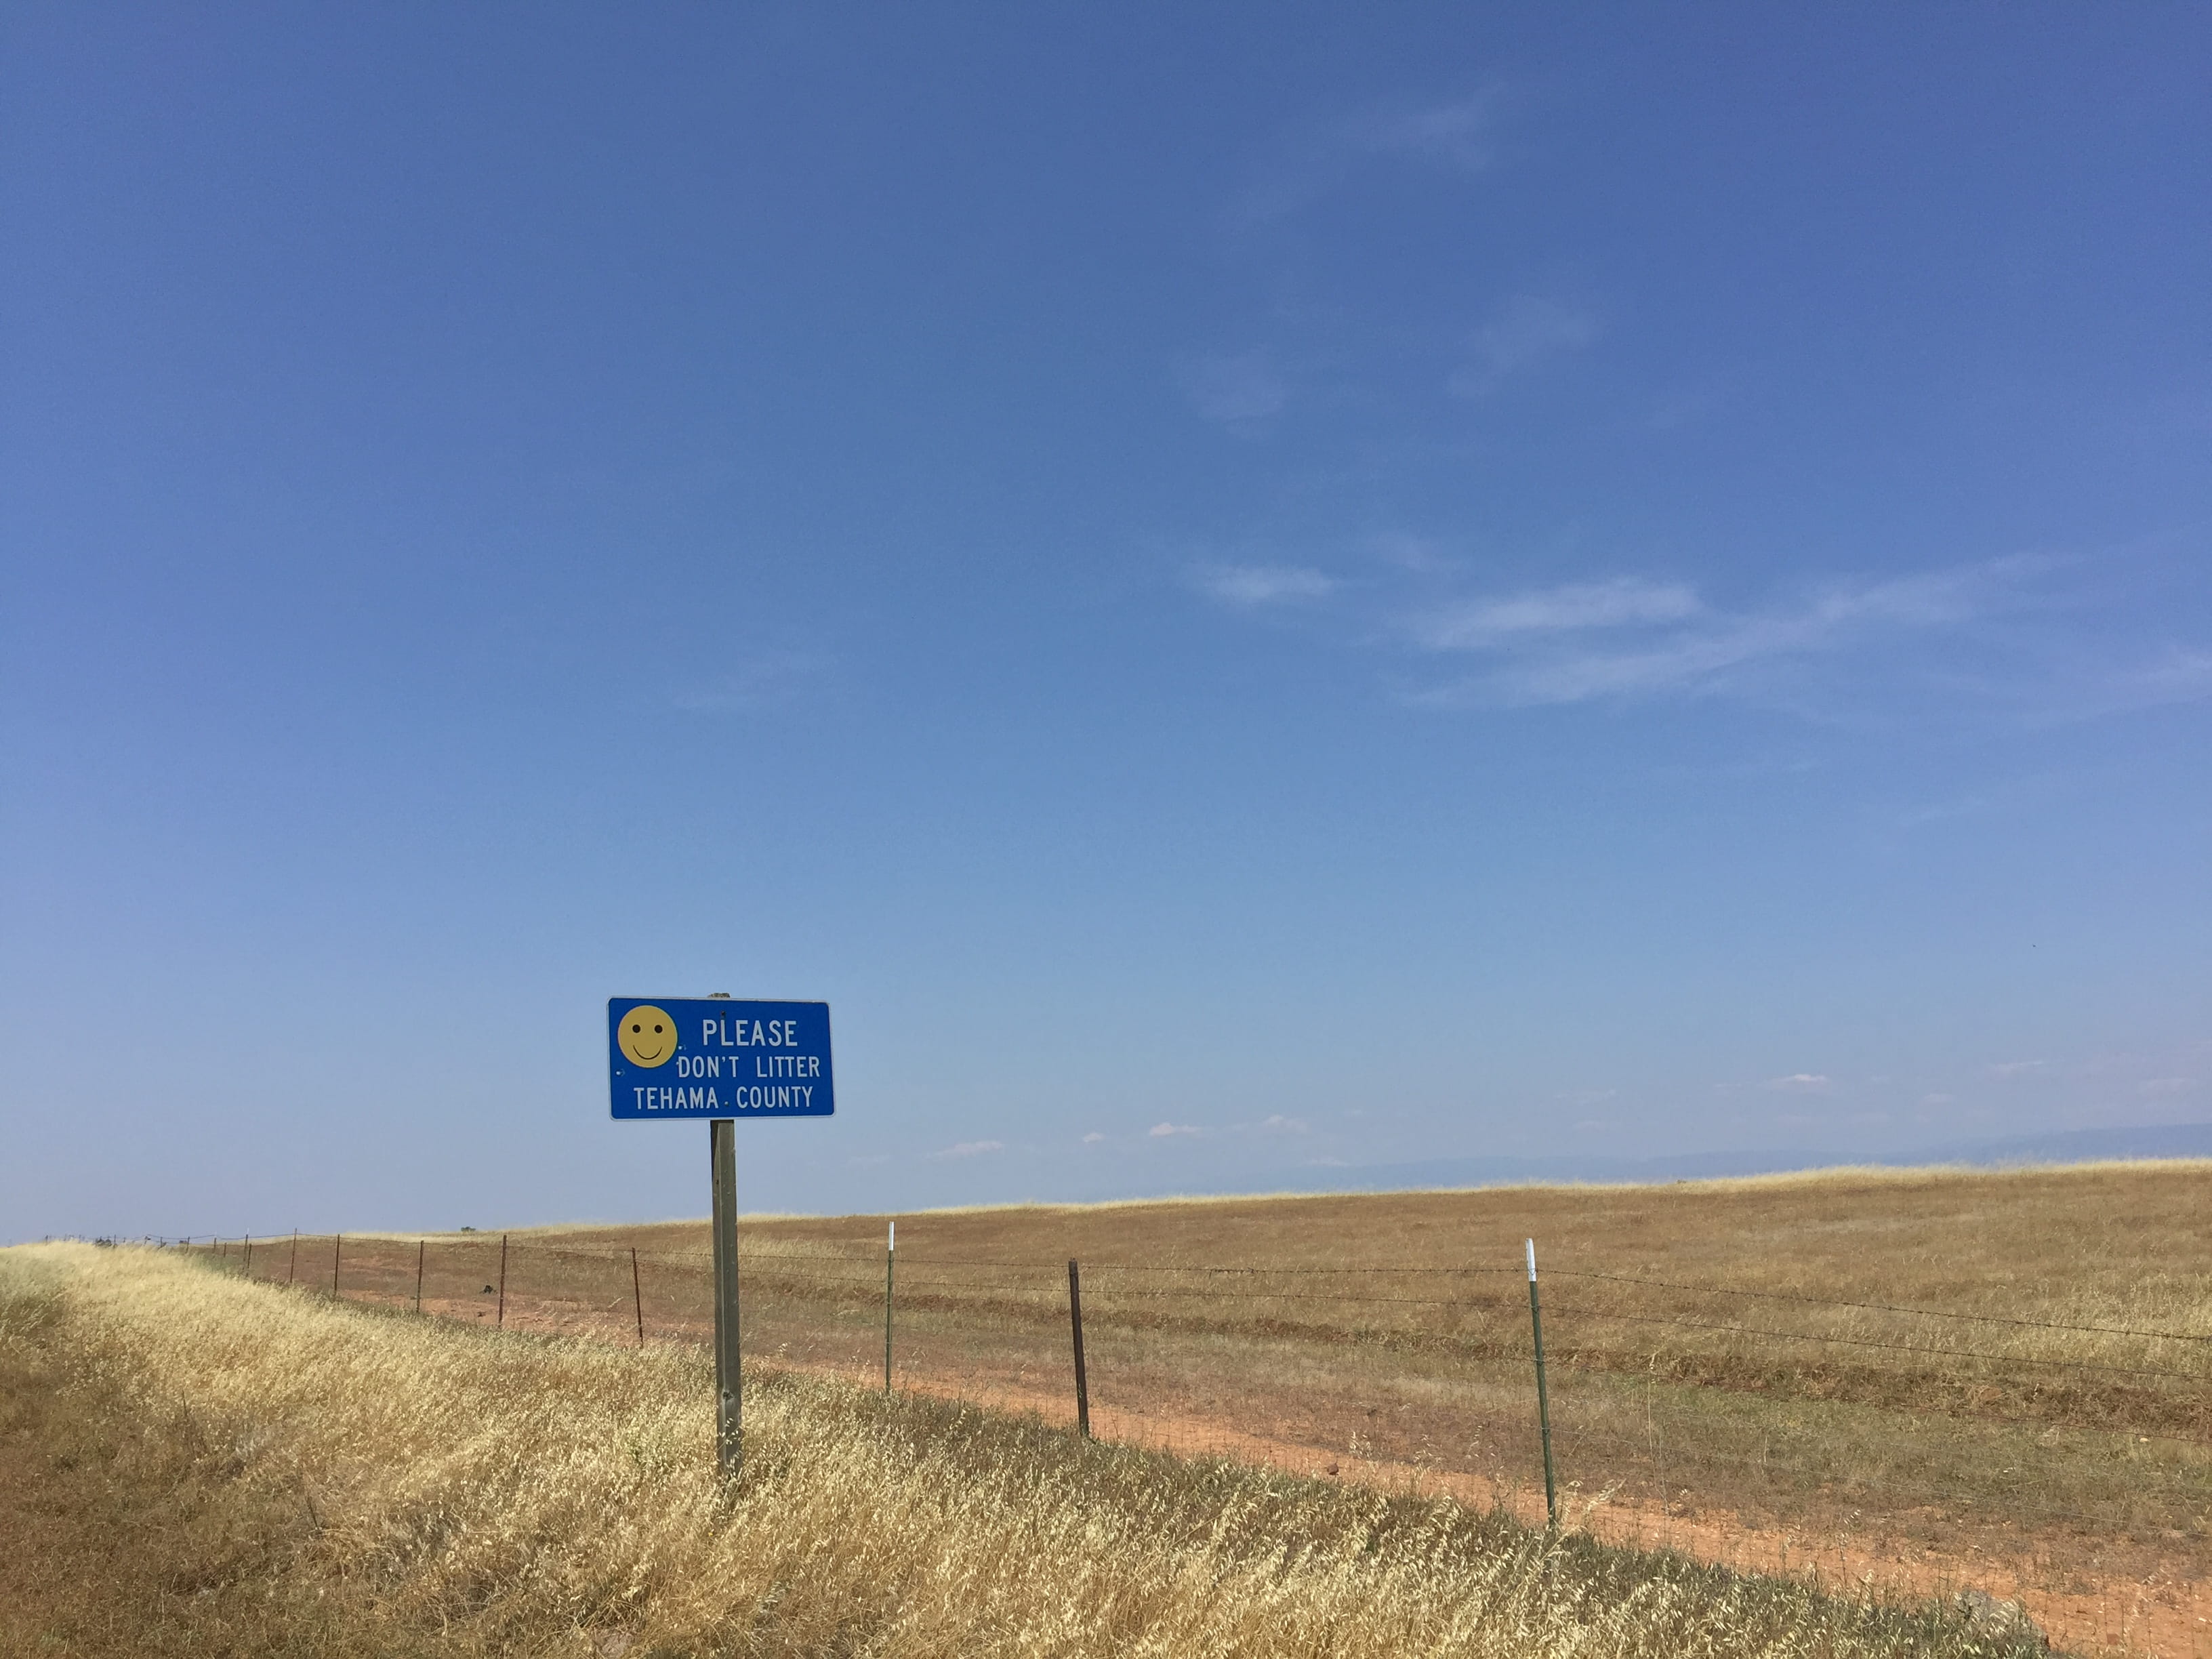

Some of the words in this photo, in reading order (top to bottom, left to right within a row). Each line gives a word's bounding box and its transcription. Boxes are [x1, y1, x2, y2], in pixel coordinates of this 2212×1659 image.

[703, 1019, 798, 1046] PLEASE
[678, 1056, 739, 1078] DON'T
[756, 1056, 820, 1078] LITTER
[634, 1087, 719, 1110] TEHAMA
[737, 1086, 813, 1109] COUNTY
